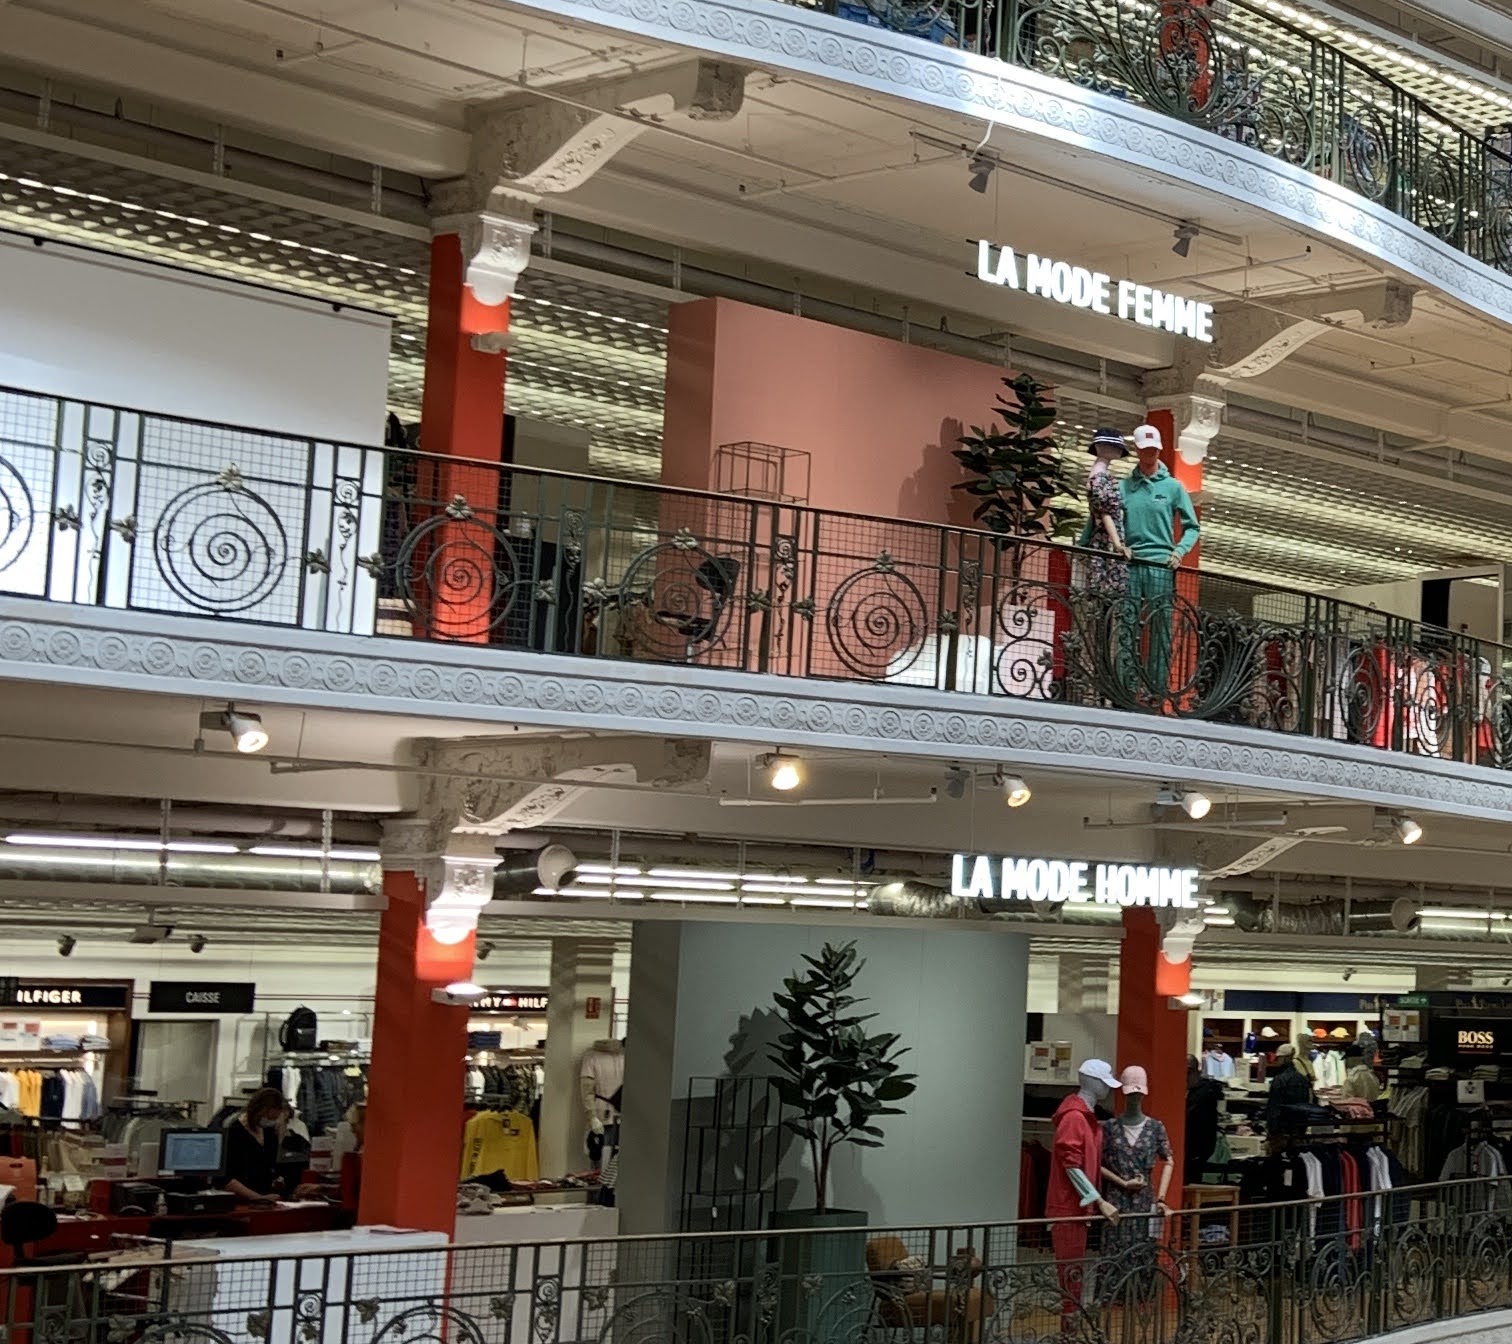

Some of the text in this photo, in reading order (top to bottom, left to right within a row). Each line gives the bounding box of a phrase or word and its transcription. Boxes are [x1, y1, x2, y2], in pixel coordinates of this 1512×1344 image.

[977, 239, 1214, 344] LA MODE FEMME
[952, 854, 1199, 909] LA MODE HOMME
[17, 990, 82, 1003] ILFIGER
[186, 992, 220, 1004] CAISSE
[518, 997, 548, 1009] HILF
[1457, 1030, 1495, 1045] BOSS
